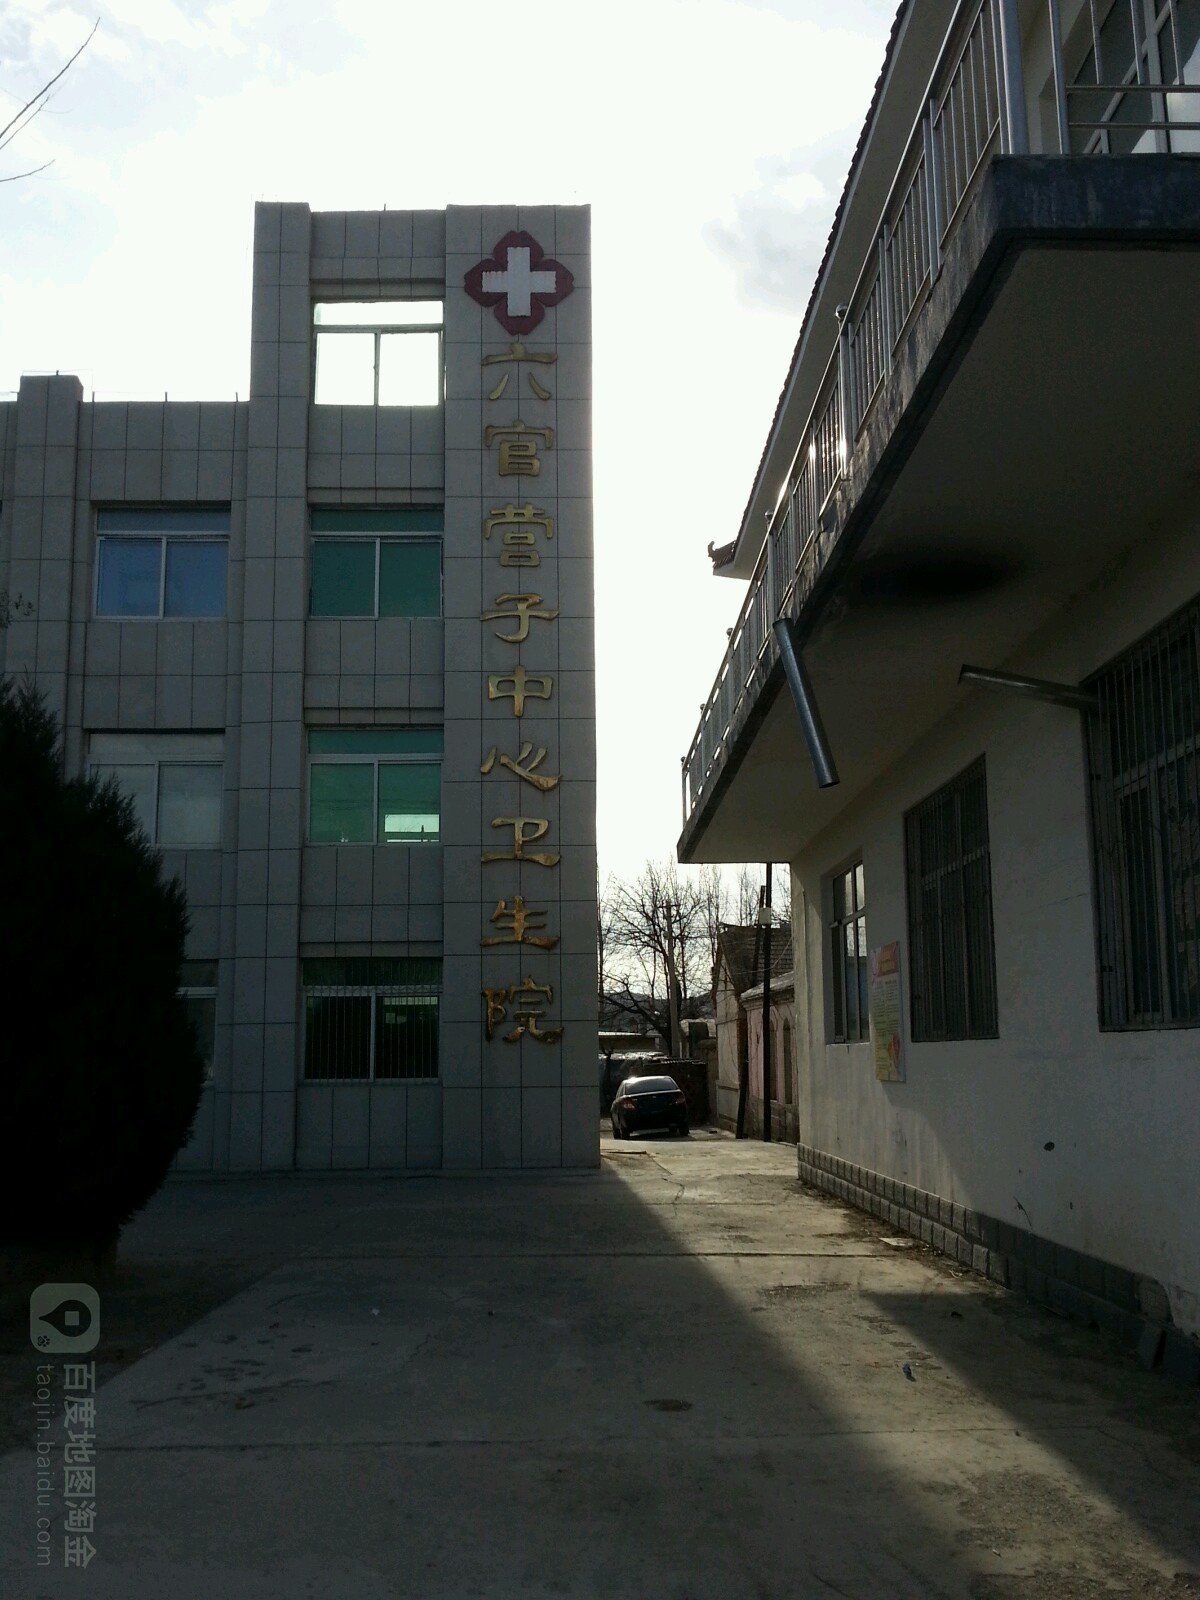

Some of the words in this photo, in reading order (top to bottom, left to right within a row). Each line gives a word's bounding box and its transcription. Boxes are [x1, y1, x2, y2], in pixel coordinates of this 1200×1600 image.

[480, 342, 563, 1044] 六官营子中心卫生院
